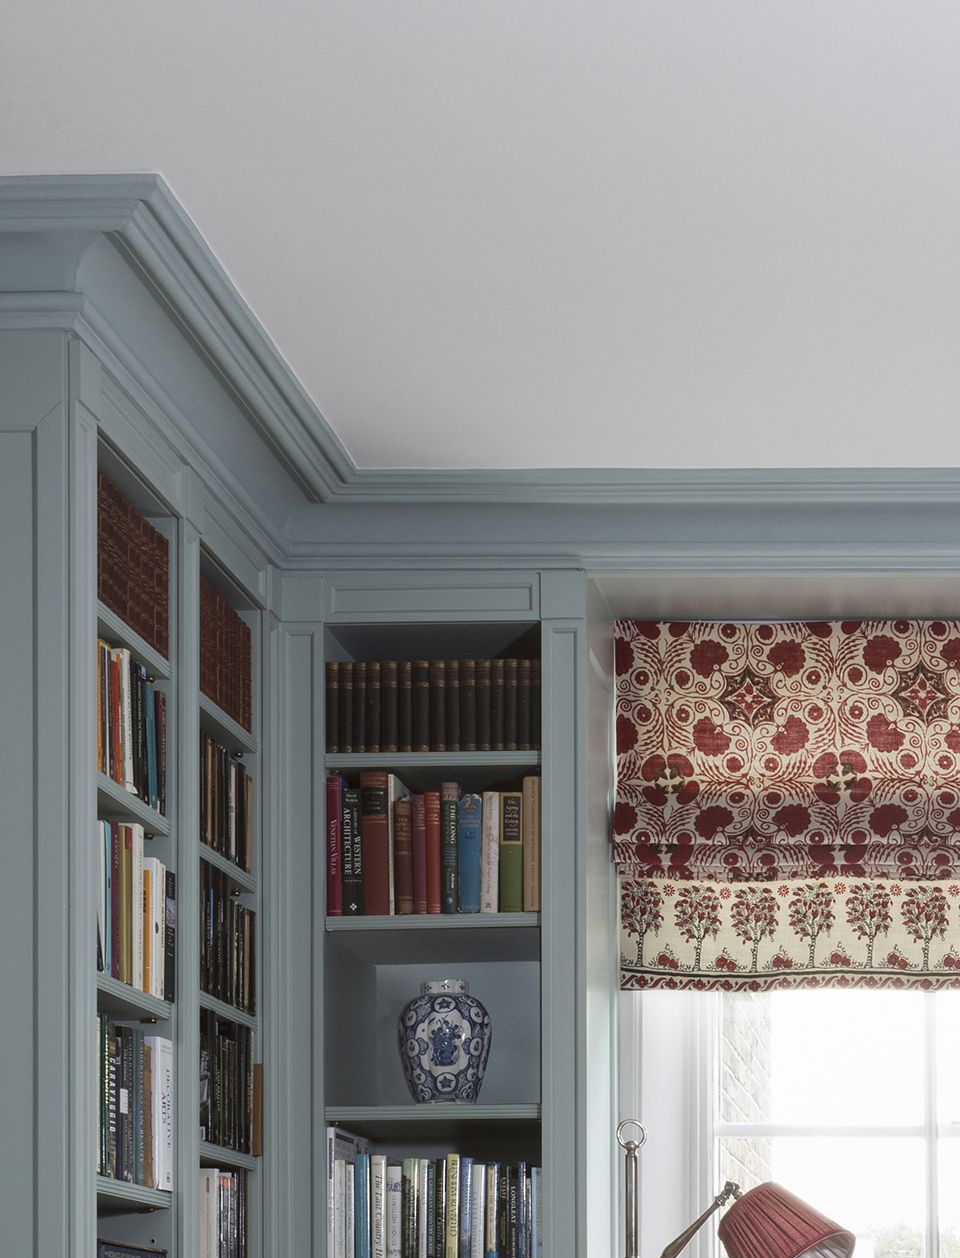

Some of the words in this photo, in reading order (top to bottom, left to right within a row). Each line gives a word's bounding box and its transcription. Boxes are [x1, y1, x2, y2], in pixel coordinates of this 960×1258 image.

[330, 819, 338, 852] VENETIAN
[344, 807, 352, 876] ARCHITECTURE
[330, 852, 338, 876] VILLAS
[354, 834, 362, 876] WESTERN
[374, 1174, 383, 1190] The
[374, 1191, 383, 1210] Last
[373, 1211, 383, 1246] Country
